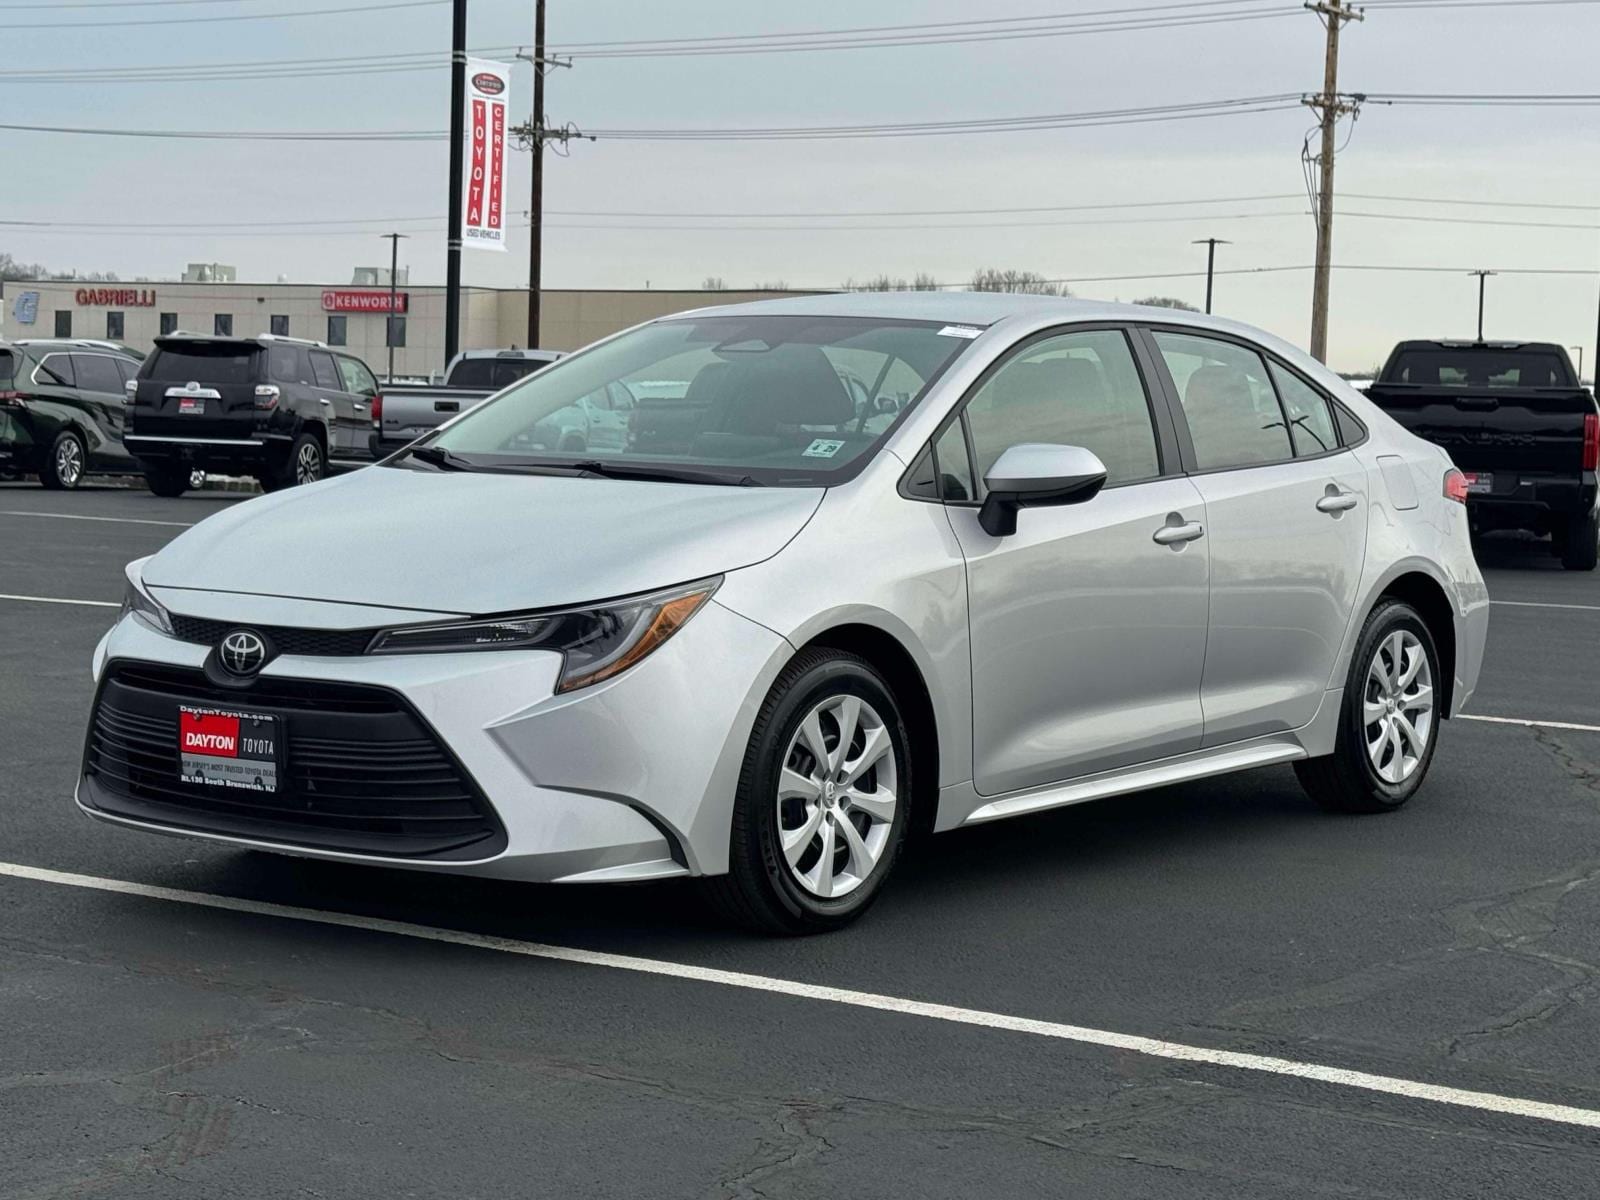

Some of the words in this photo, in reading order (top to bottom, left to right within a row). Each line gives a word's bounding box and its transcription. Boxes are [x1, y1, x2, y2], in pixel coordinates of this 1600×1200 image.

[470, 105, 484, 222] TOYOTA
[490, 107, 503, 225] CERTIFIED
[480, 229, 501, 240] VEHICLES
[76, 288, 156, 307] GABRIELLI
[336, 295, 403, 309] KENWORTH
[180, 705, 273, 721] DaytonToyota.com
[186, 732, 235, 750] DAYTON
[243, 738, 274, 755] TOYOTA
[244, 767, 262, 776] TOYOTA
[265, 785, 276, 793] NJ
